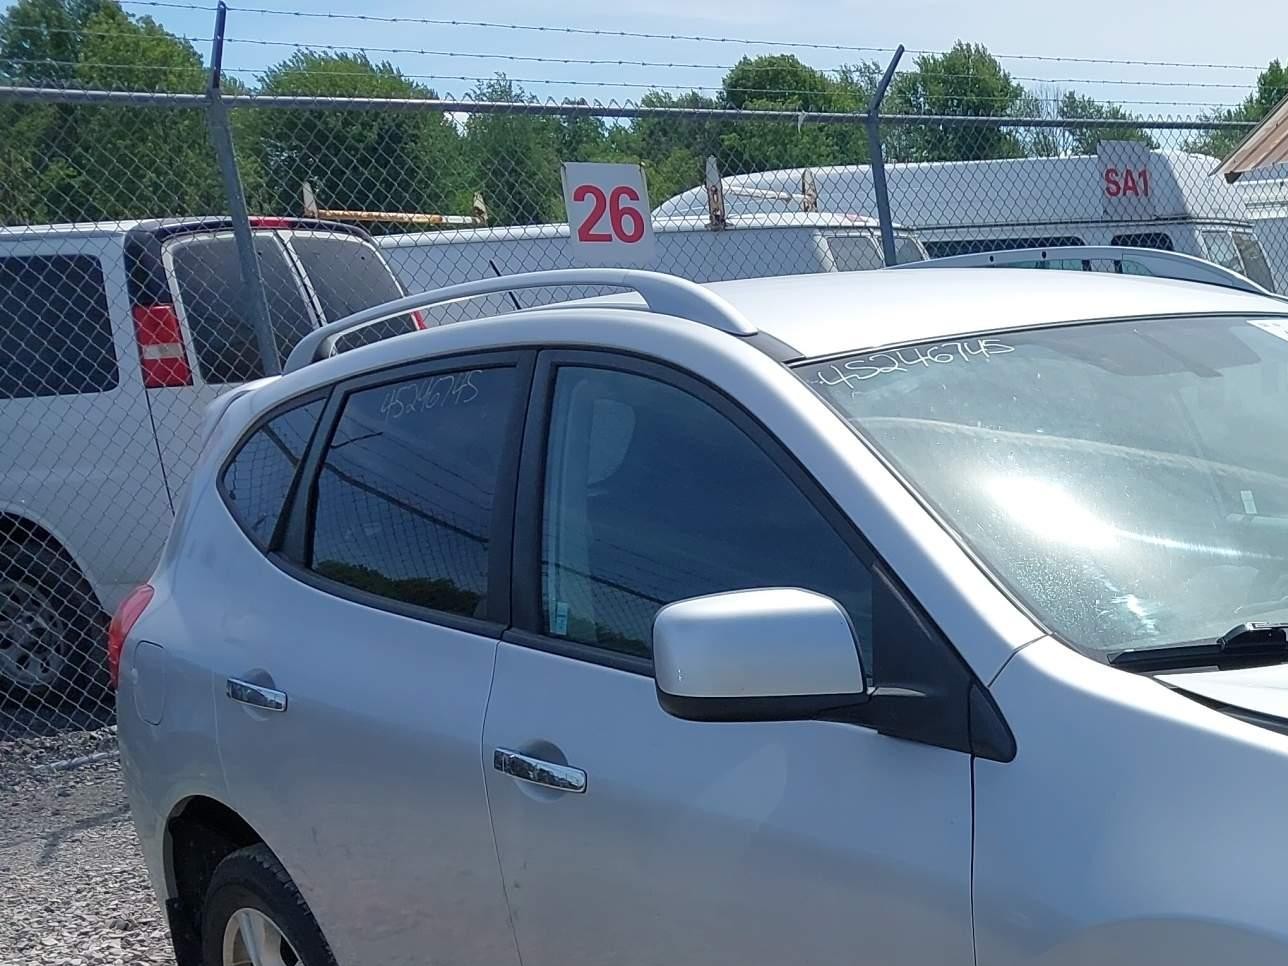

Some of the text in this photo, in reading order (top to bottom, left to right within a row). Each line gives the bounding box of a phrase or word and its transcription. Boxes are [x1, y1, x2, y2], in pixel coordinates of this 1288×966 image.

[1104, 167, 1149, 197] SA1
[573, 184, 645, 243] 26
[818, 339, 1015, 389] 45246745
